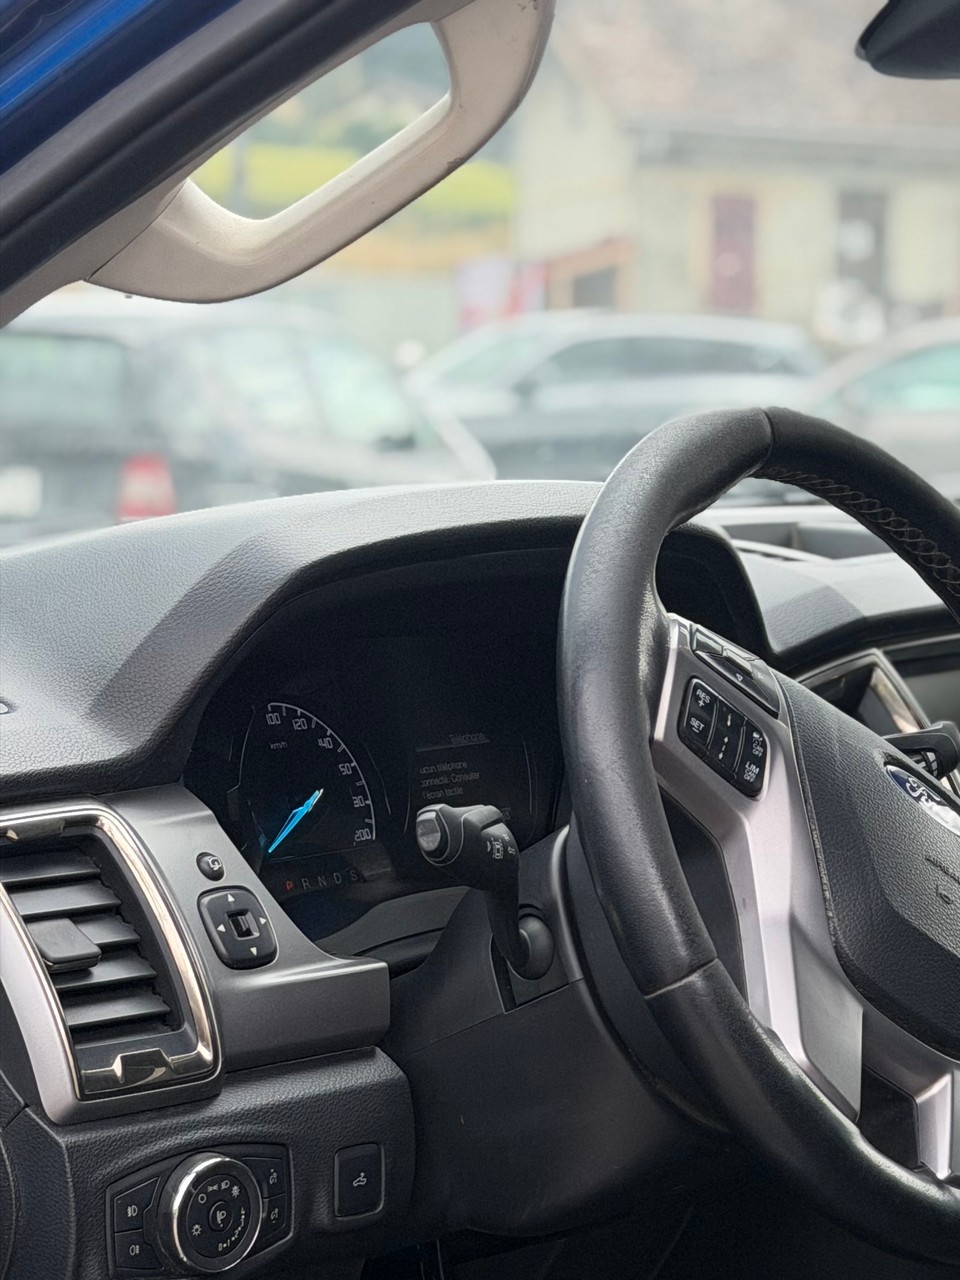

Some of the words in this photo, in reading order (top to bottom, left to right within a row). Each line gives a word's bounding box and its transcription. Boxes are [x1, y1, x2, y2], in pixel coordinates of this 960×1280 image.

[696, 689, 711, 703] RES
[265, 713, 281, 725] 100
[292, 718, 308, 731] 120
[689, 717, 705, 731] SET
[745, 761, 760, 775] LIM
